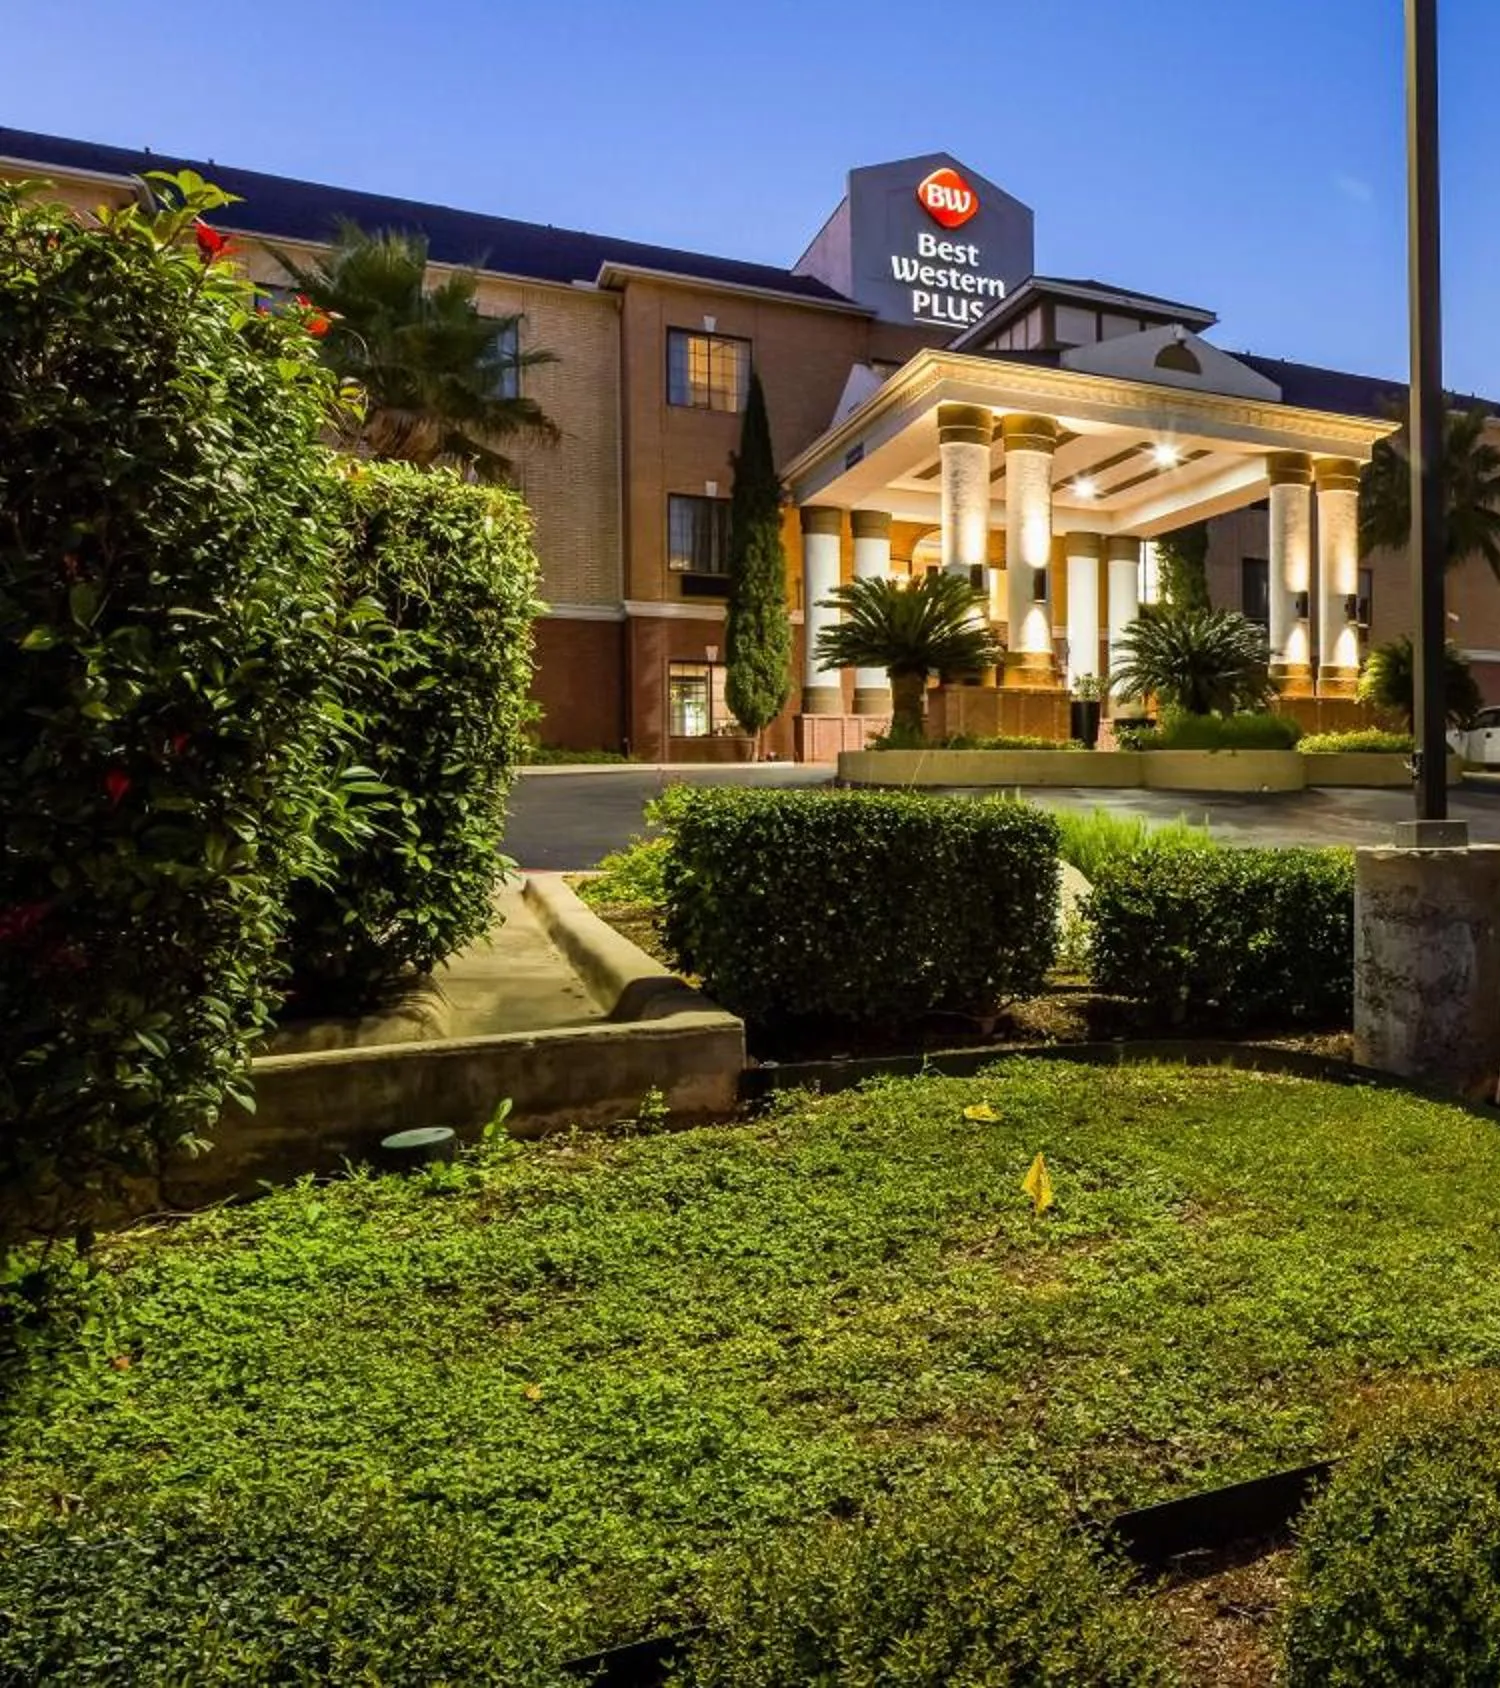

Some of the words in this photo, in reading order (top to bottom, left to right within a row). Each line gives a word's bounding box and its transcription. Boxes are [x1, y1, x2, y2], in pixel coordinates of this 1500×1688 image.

[926, 183, 972, 213] BW
[917, 232, 980, 267] Best
[890, 255, 1006, 299] Western
[912, 289, 984, 323] PLUS
